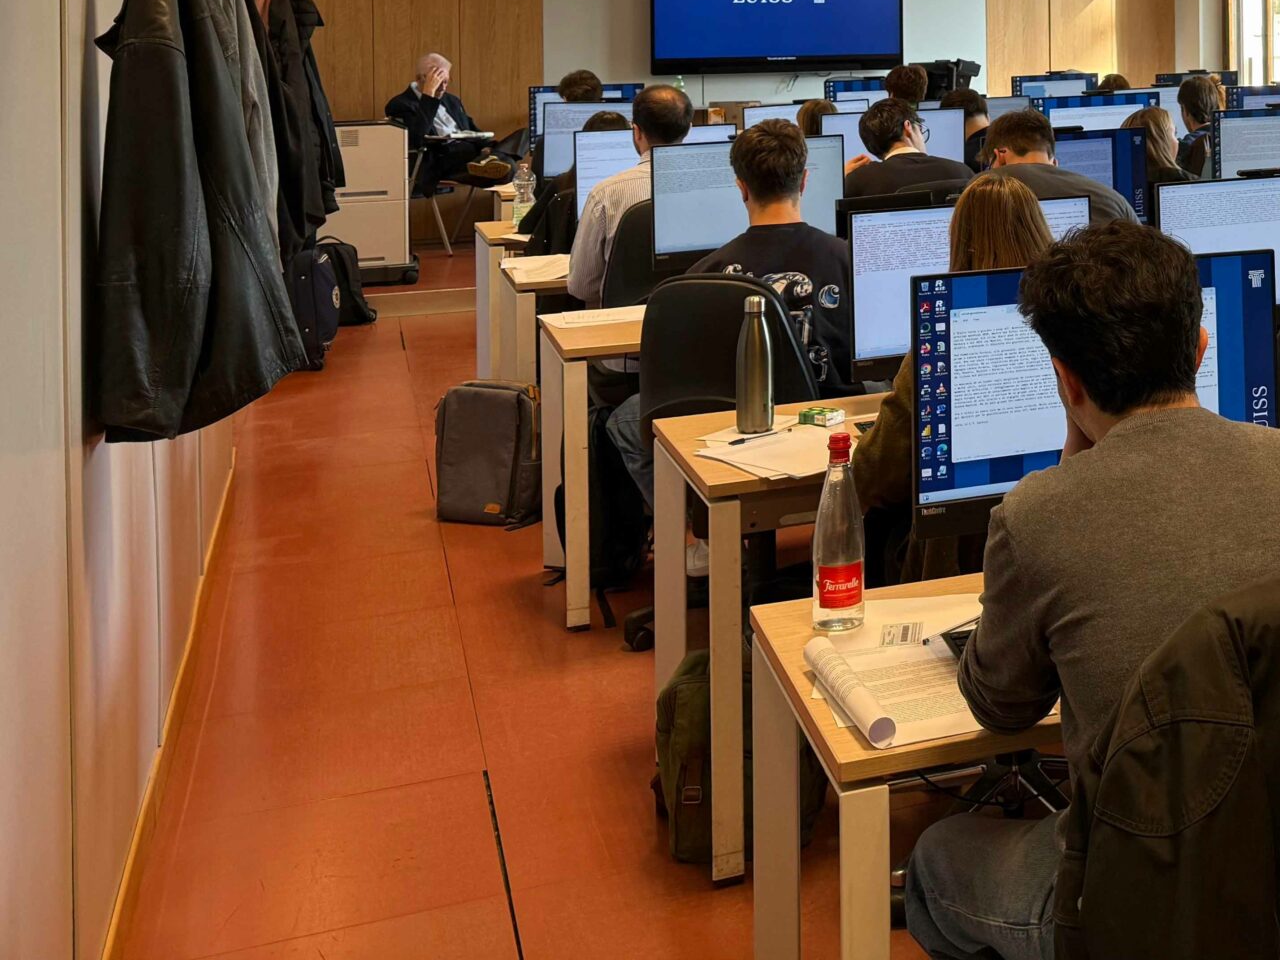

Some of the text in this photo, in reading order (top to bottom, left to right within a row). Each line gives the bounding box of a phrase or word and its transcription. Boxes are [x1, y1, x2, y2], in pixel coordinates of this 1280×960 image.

[1135, 188, 1144, 215] LUISS
[1252, 385, 1269, 428] UISS
[823, 576, 860, 593] Ferrarelle
